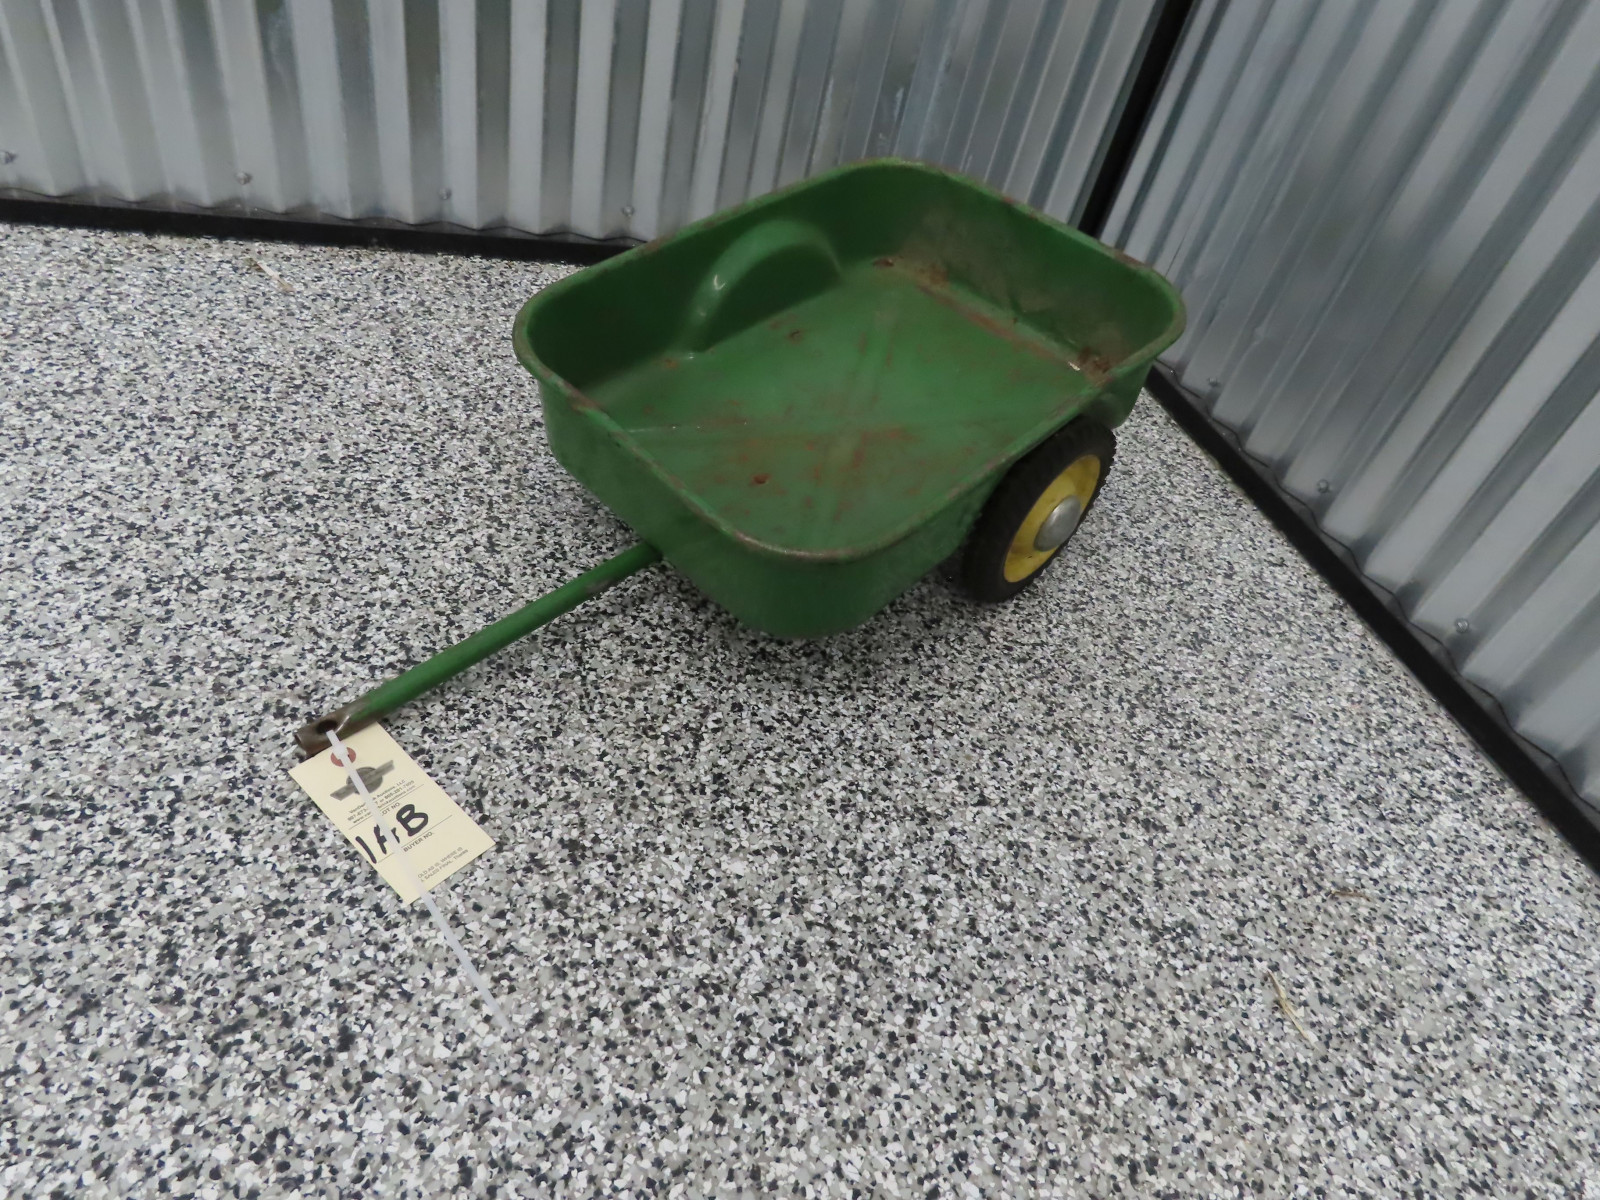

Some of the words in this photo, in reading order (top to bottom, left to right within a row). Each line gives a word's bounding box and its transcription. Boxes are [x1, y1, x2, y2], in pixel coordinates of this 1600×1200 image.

[381, 807, 391, 816] OT
[403, 837, 423, 852] BUYER
[418, 870, 428, 878] OLD
